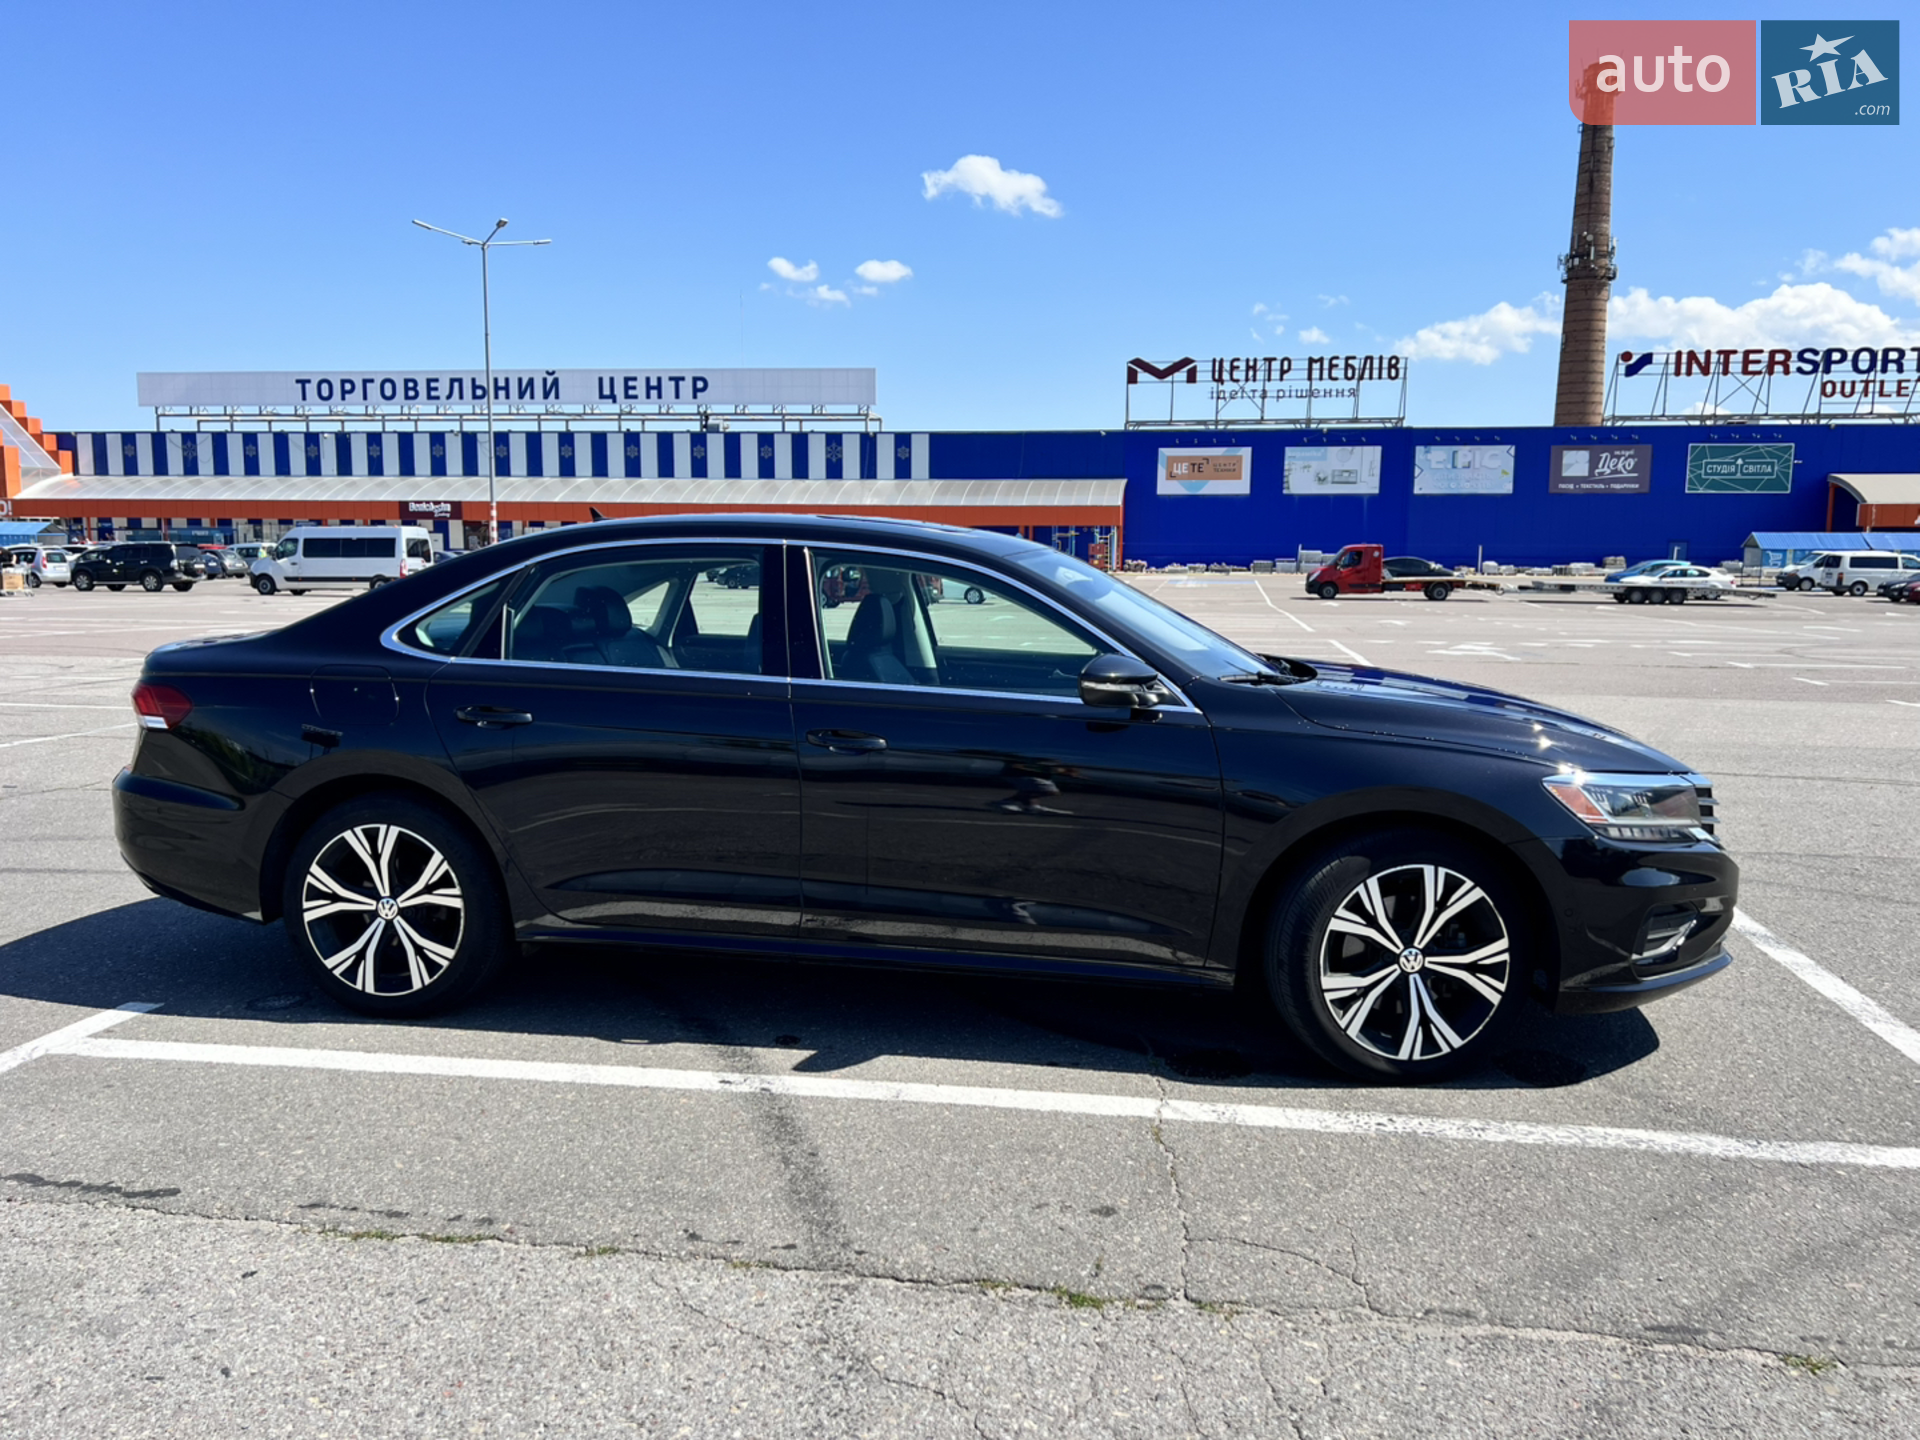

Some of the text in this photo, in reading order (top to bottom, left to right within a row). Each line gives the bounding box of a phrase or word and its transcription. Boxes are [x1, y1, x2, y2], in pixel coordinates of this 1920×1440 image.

[1211, 356, 1292, 385] ЦЕНТР
[1307, 354, 1401, 382] МЕБЛІВ
[295, 370, 709, 403] ТОРГОВЕЛЬНИЙ ЦЕНТР
[1276, 385, 1356, 402] рішення
[1706, 464, 1772, 474] СТУДІЯ СВІТЛА
